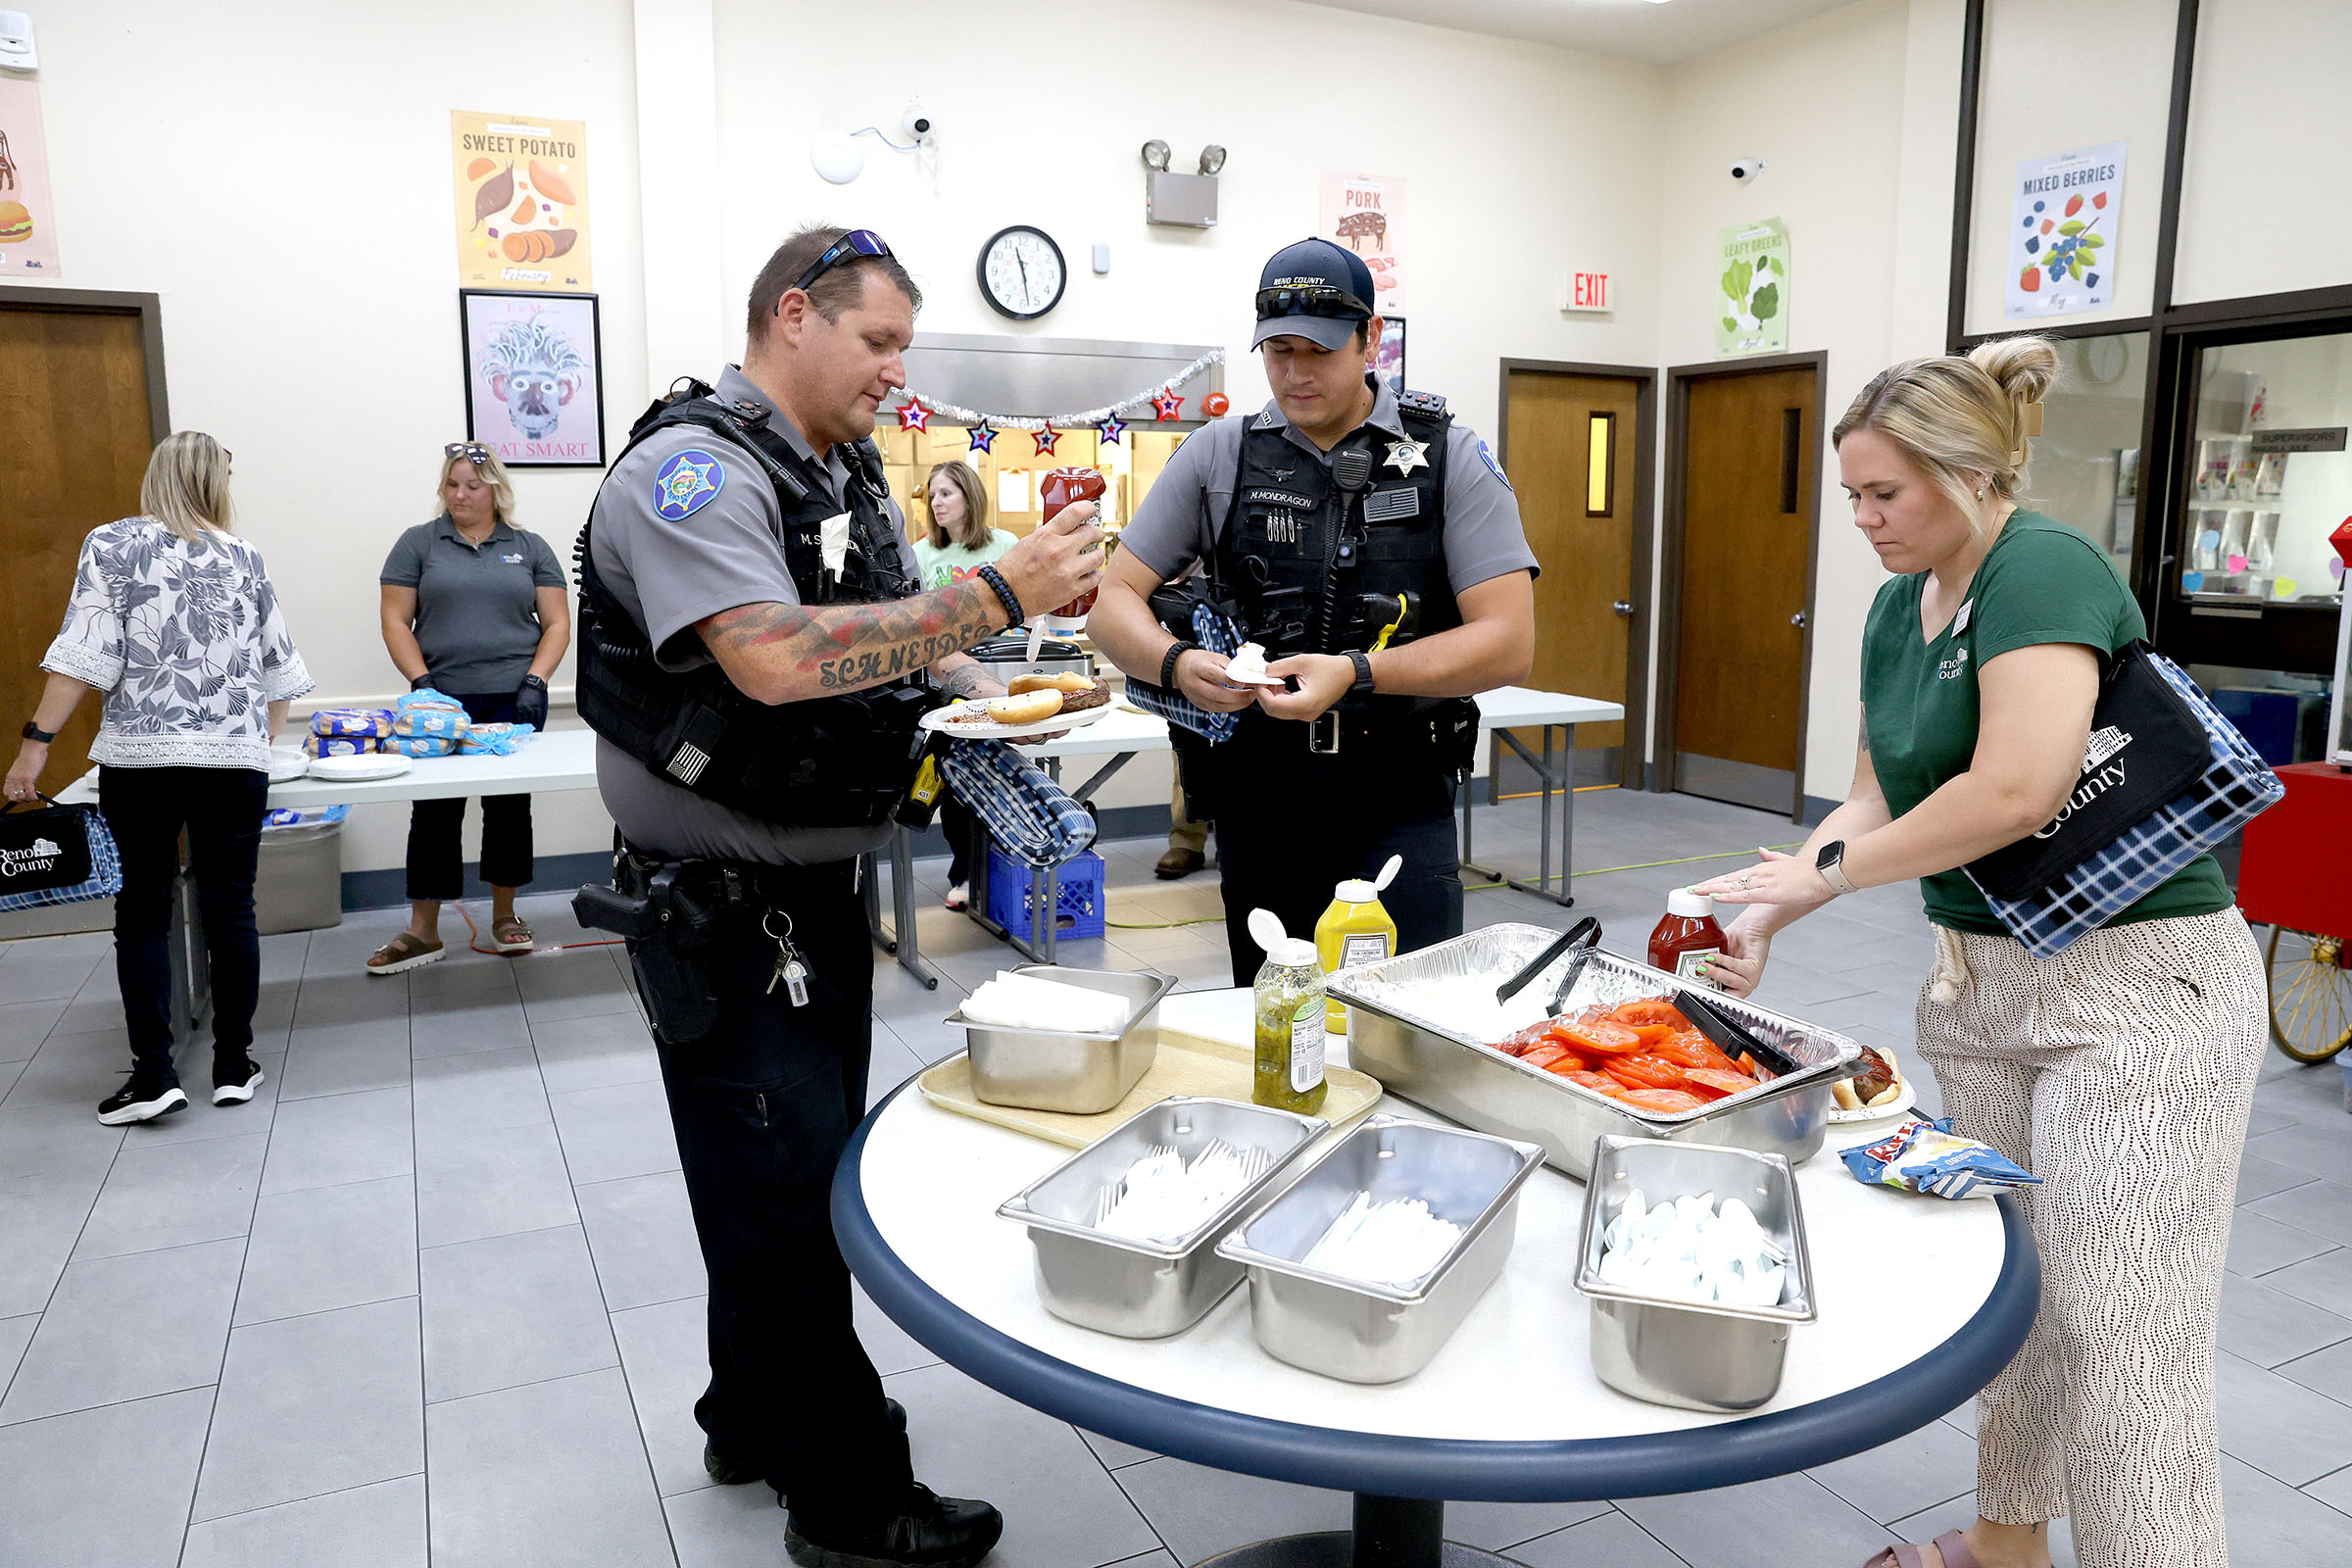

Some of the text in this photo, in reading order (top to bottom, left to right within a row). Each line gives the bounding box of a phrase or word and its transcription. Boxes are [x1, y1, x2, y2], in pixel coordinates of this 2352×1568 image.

[463, 133, 575, 158] SWEET POTATO
[2024, 175, 2059, 196] MIXED
[2063, 165, 2115, 188] BERRIES
[1347, 189, 1381, 209] PORK
[1018, 236, 1029, 246] 12
[1725, 235, 1782, 258] LEAFY GREENS
[993, 251, 1004, 261] 10
[1045, 254, 1052, 264] 2
[991, 266, 998, 275] 9
[1049, 270, 1054, 279] 3
[1273, 276, 1292, 285] RENO
[994, 282, 1001, 291] 8
[1044, 285, 1050, 295] 4
[1575, 273, 1608, 307] EXIT
[1033, 297, 1040, 306] 5
[2261, 432, 2336, 443] SUPERVISORS
[525, 443, 588, 457] SMART
[1, 858, 54, 876] County
